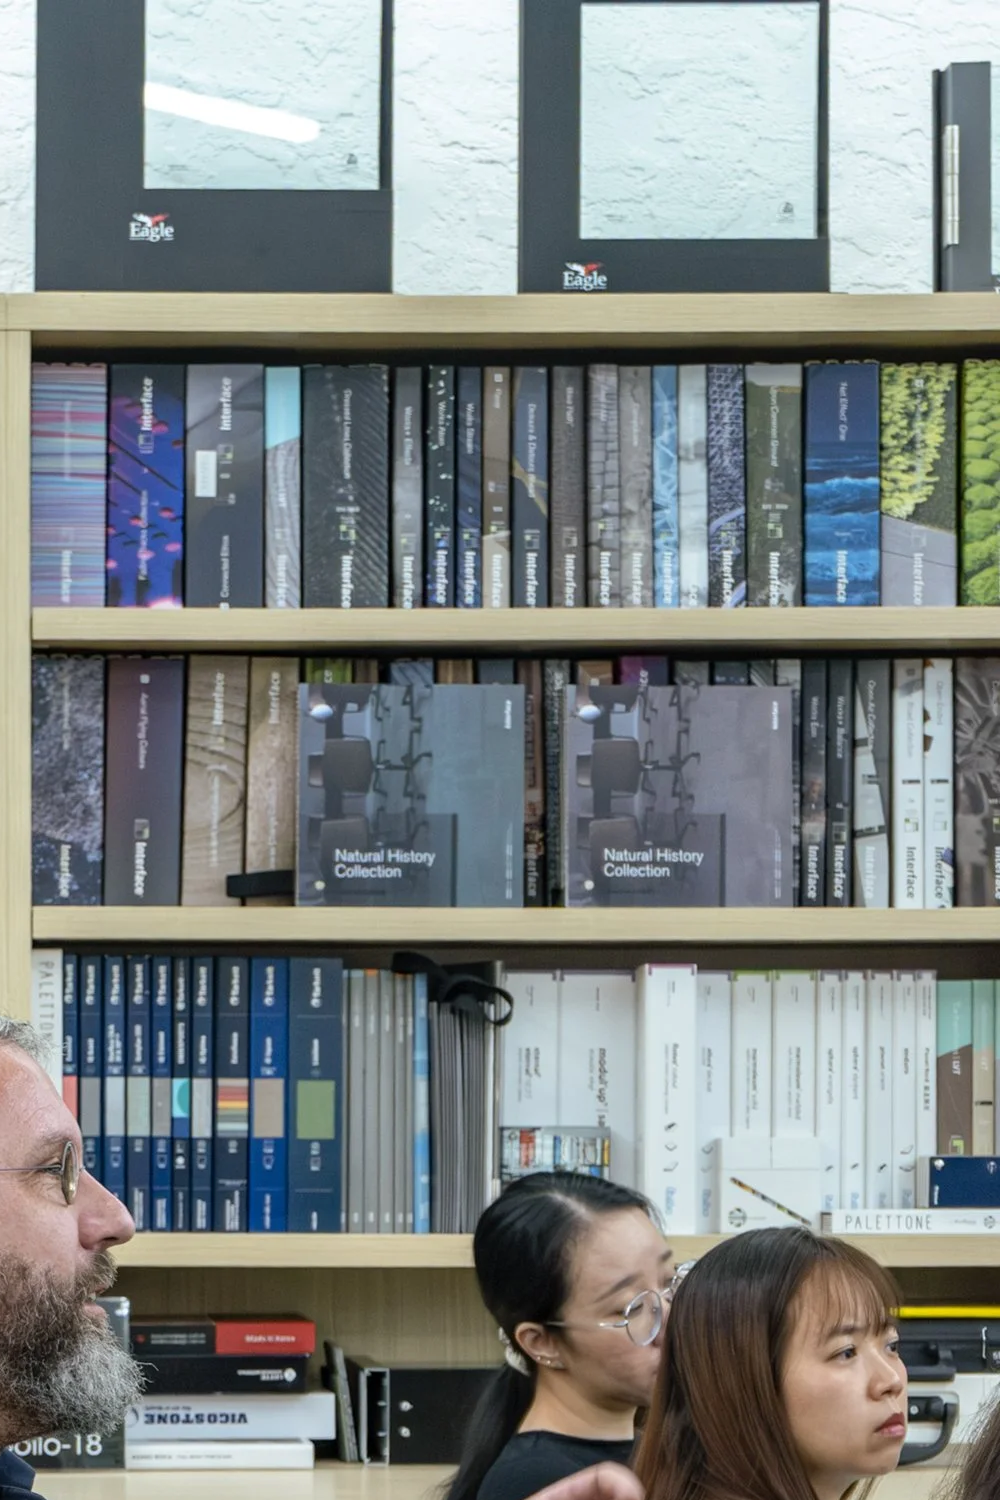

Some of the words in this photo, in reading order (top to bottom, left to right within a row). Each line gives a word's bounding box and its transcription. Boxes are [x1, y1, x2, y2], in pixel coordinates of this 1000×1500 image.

[129, 222, 174, 242] Eagle
[563, 271, 607, 291] Eagle
[141, 377, 153, 431] Interface
[220, 377, 232, 431] Interface
[341, 555, 354, 609] Interface
[402, 556, 414, 609] Interface
[435, 551, 447, 604] Interface
[465, 551, 477, 604] Interface
[492, 554, 504, 607] Interface
[526, 553, 538, 607] Interface
[565, 554, 576, 607] Interface
[601, 551, 612, 606] Interface
[633, 552, 644, 605] Interface
[663, 552, 674, 605] Interface
[722, 551, 734, 603] Interface
[769, 552, 781, 607] Interface
[837, 551, 848, 603] Interface
[913, 553, 925, 606] Interface
[213, 671, 224, 725] Interface
[270, 672, 280, 724] Interface
[60, 844, 71, 897] Interface
[135, 841, 146, 896] Interface
[335, 849, 384, 864] Natural
[388, 849, 435, 867] History
[335, 864, 402, 878] Collection
[527, 843, 536, 896] Interface
[604, 849, 653, 864] Natural
[656, 849, 704, 867] History
[604, 864, 670, 877] Collection
[808, 846, 819, 899] Interface
[835, 845, 844, 899] Interface
[866, 846, 875, 899] Interface
[906, 847, 916, 899] Interface
[935, 846, 945, 898] Interface
[845, 1214, 932, 1231] PALETTONE
[144, 1412, 248, 1425] VICOSTONE
